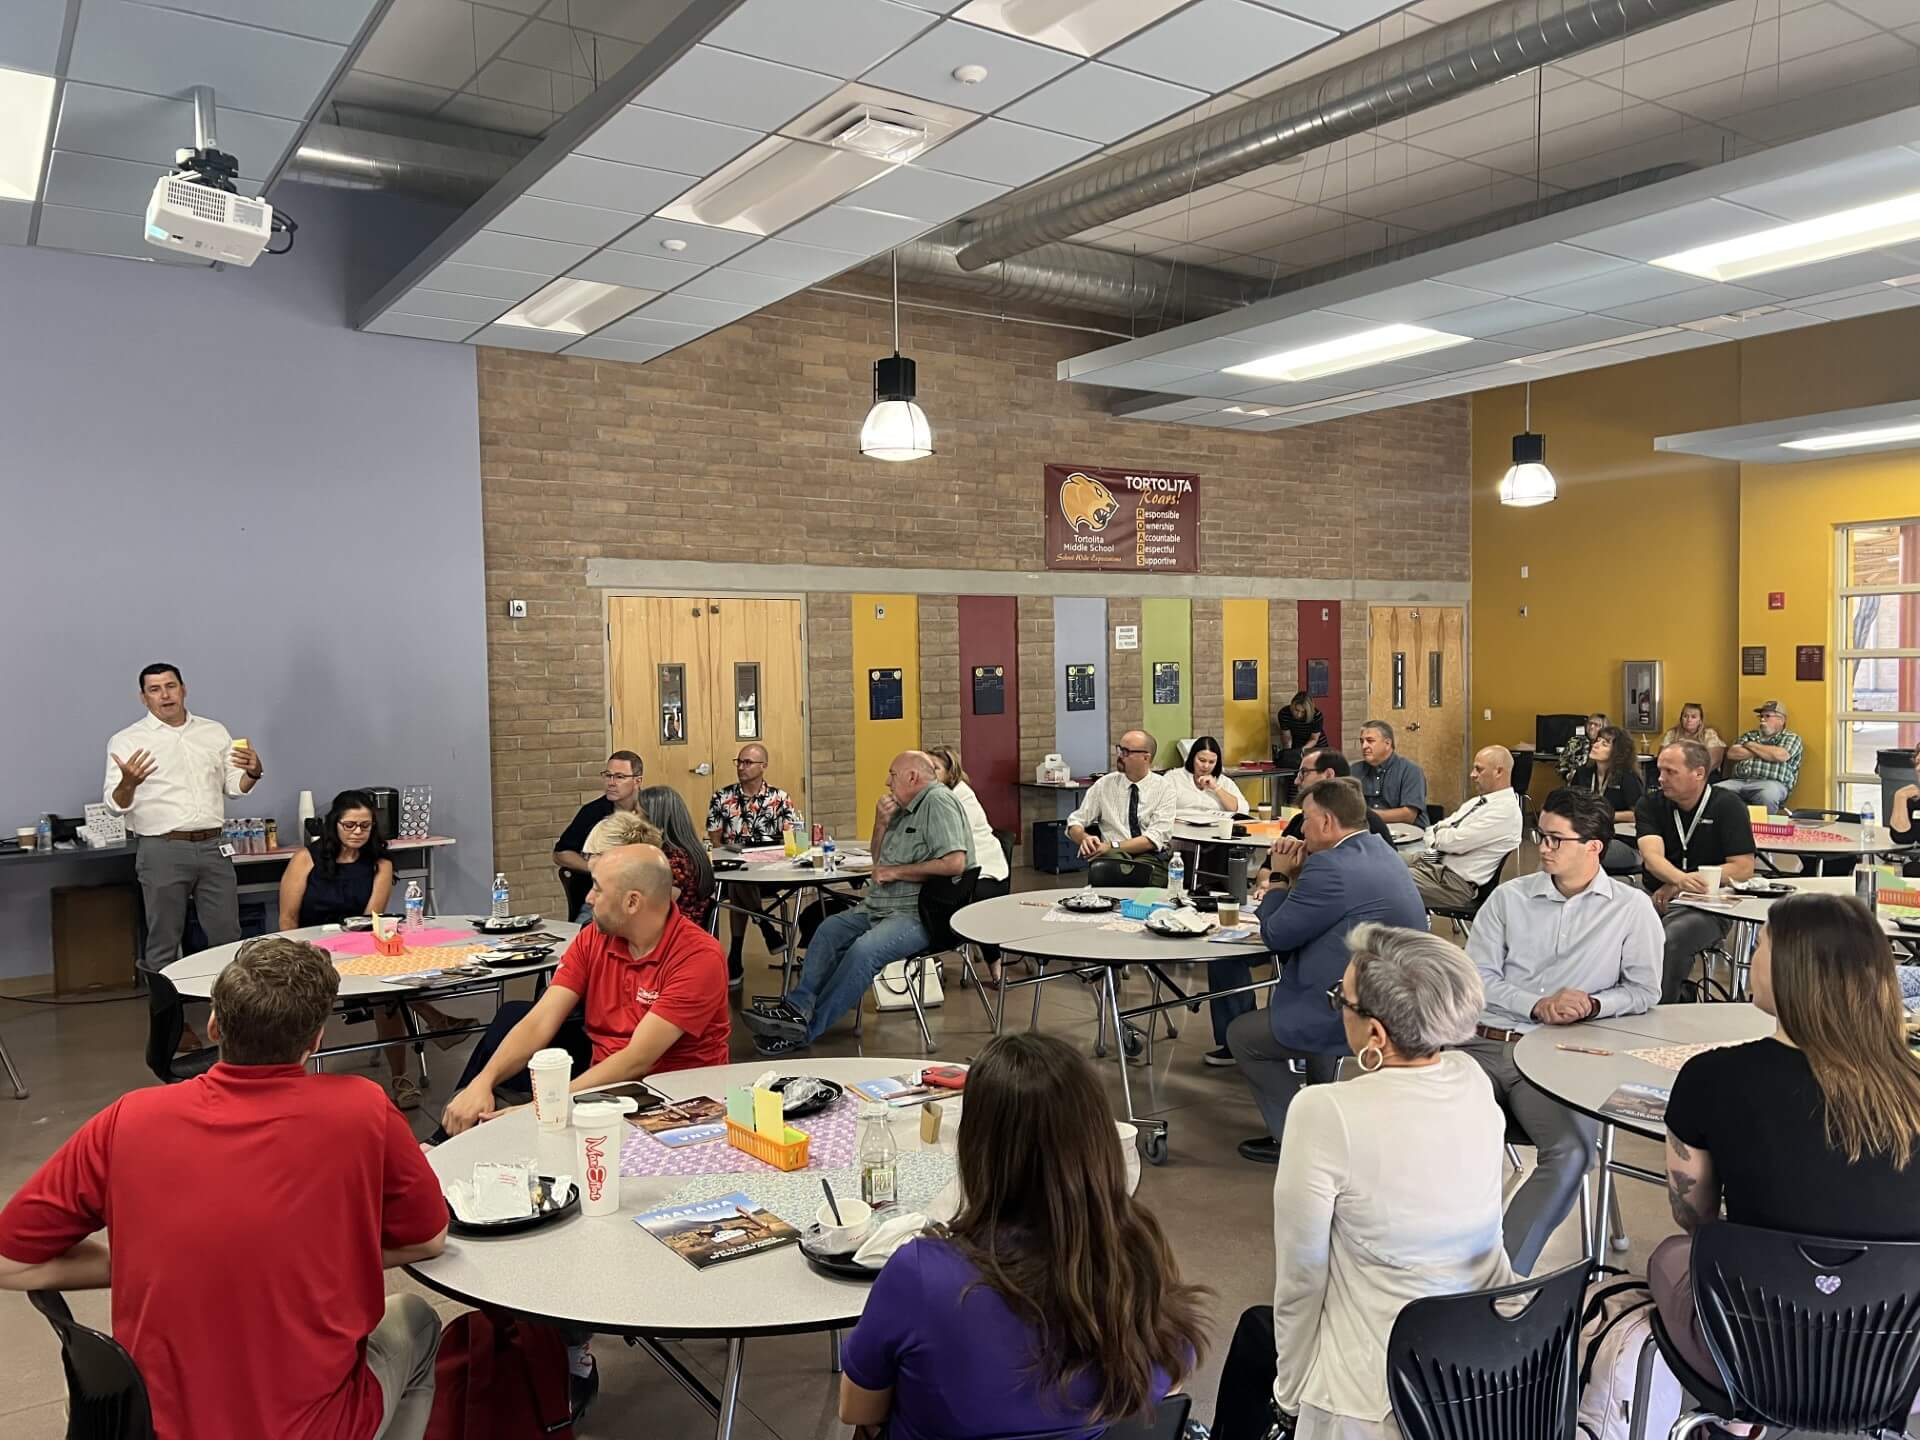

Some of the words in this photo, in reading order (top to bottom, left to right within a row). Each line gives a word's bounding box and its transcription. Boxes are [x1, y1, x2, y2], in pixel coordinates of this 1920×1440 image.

[1125, 476, 1192, 493] TORTOLITA
[1138, 487, 1181, 506] Roars!
[1137, 508, 1180, 520] Responsible
[1137, 520, 1175, 532] Ownership
[1073, 534, 1105, 544] Tortolita
[1138, 532, 1181, 543] Accountable
[1063, 543, 1088, 552] Middle
[1089, 544, 1115, 553] School
[1137, 543, 1175, 554] Respectful
[1137, 555, 1177, 567] Supportive
[655, 1200, 733, 1221] MARANA
